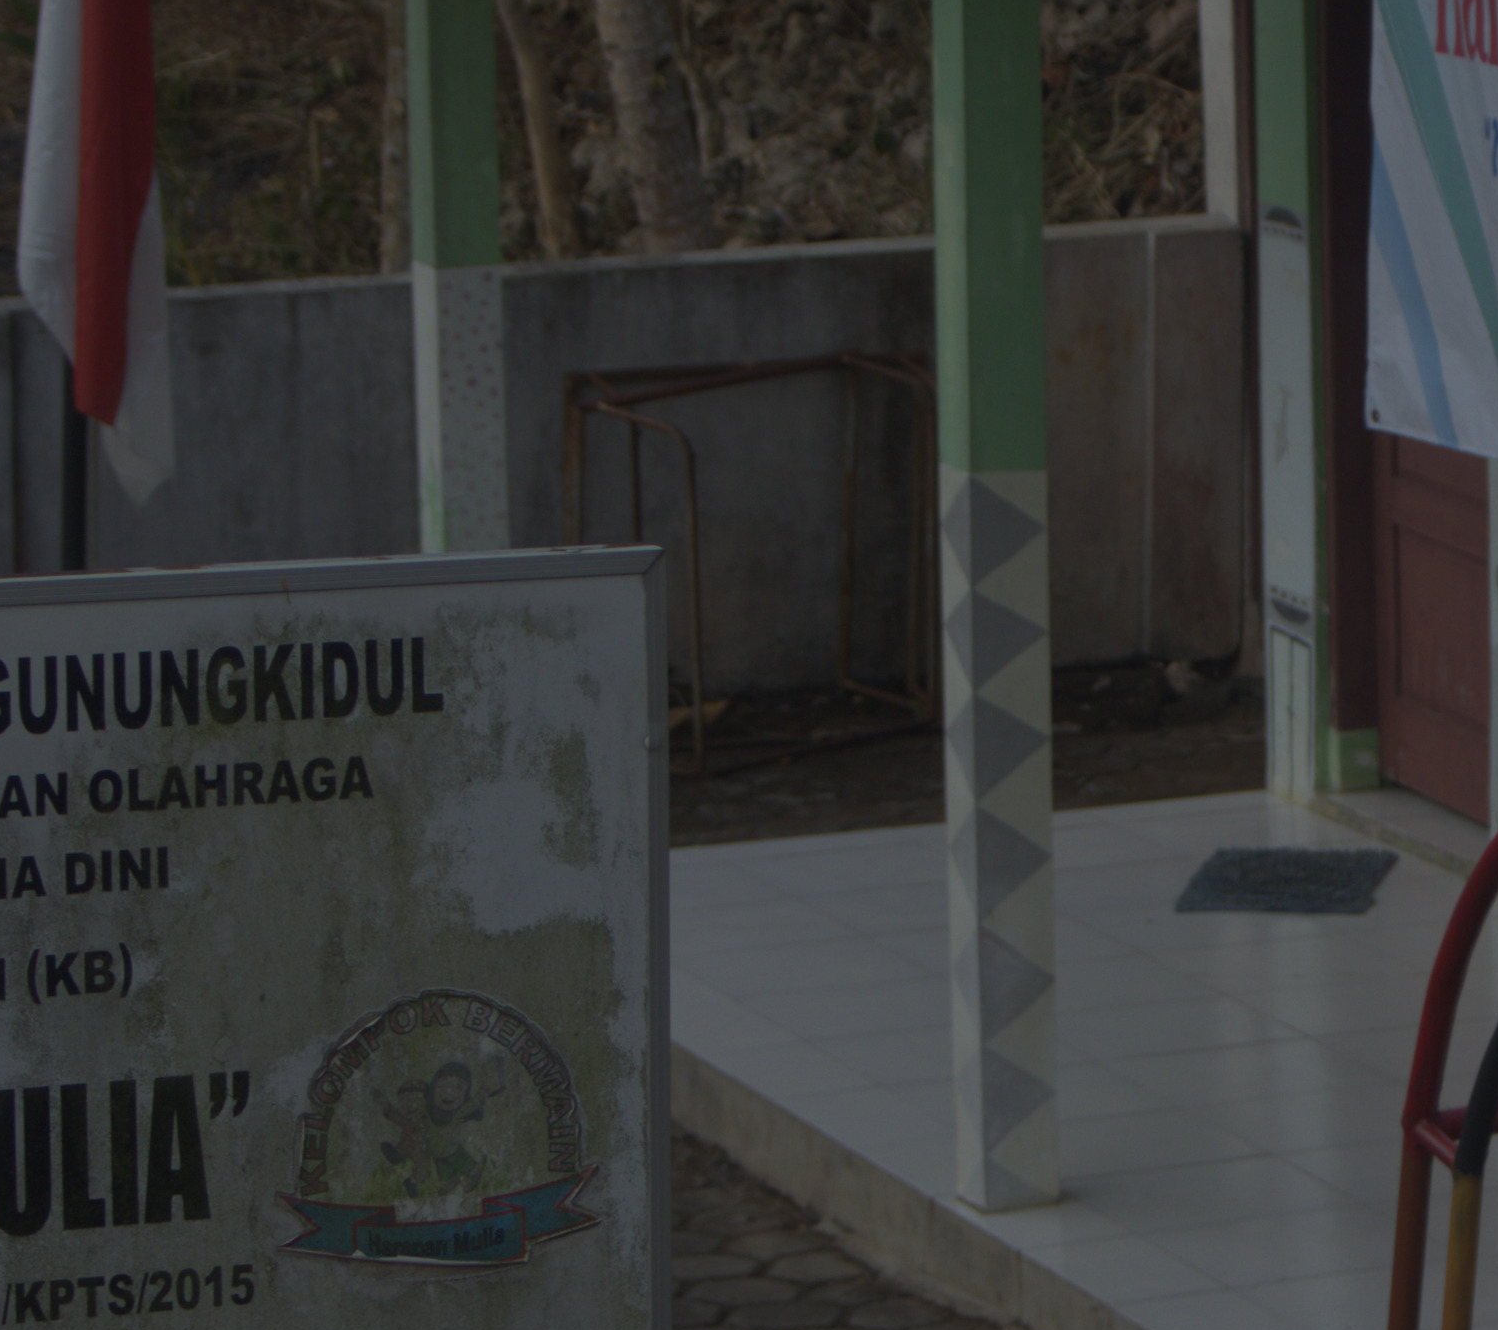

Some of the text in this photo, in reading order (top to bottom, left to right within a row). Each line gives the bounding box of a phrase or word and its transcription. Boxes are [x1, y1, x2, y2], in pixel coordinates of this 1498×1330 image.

[85, 751, 374, 815] OLAHRAGA
[64, 846, 169, 896] DINI
[26, 942, 133, 1006] (KB)
[299, 996, 577, 1197] KELOMPOK BERMAIN
[453, 1227, 505, 1253] Mulia
